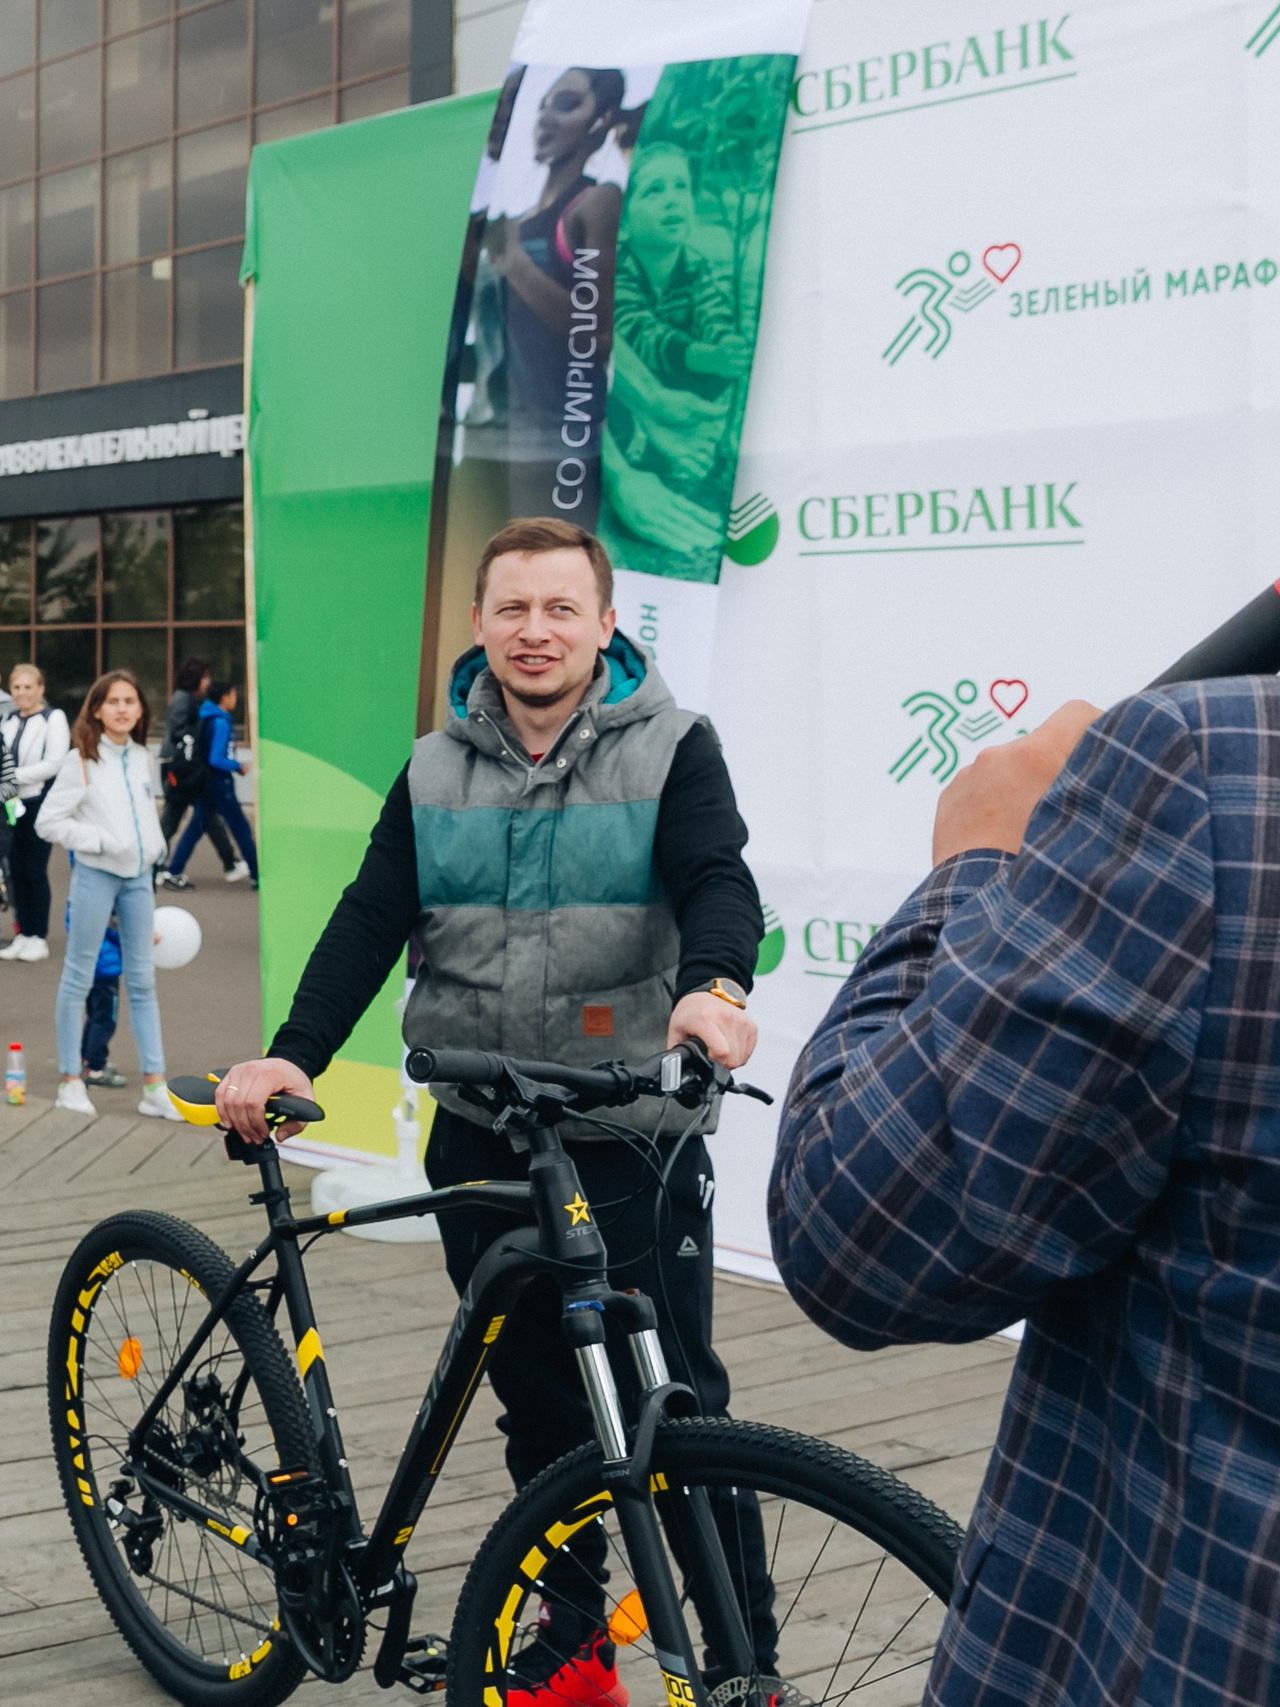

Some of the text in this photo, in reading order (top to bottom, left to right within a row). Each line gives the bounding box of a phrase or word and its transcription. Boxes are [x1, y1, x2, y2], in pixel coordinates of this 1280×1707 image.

[791, 13, 1075, 117] СБЕРБАНК
[1009, 267, 1150, 318] ЗЕЛЕНЫЙ
[797, 481, 1083, 541] СБЕРБАНК
